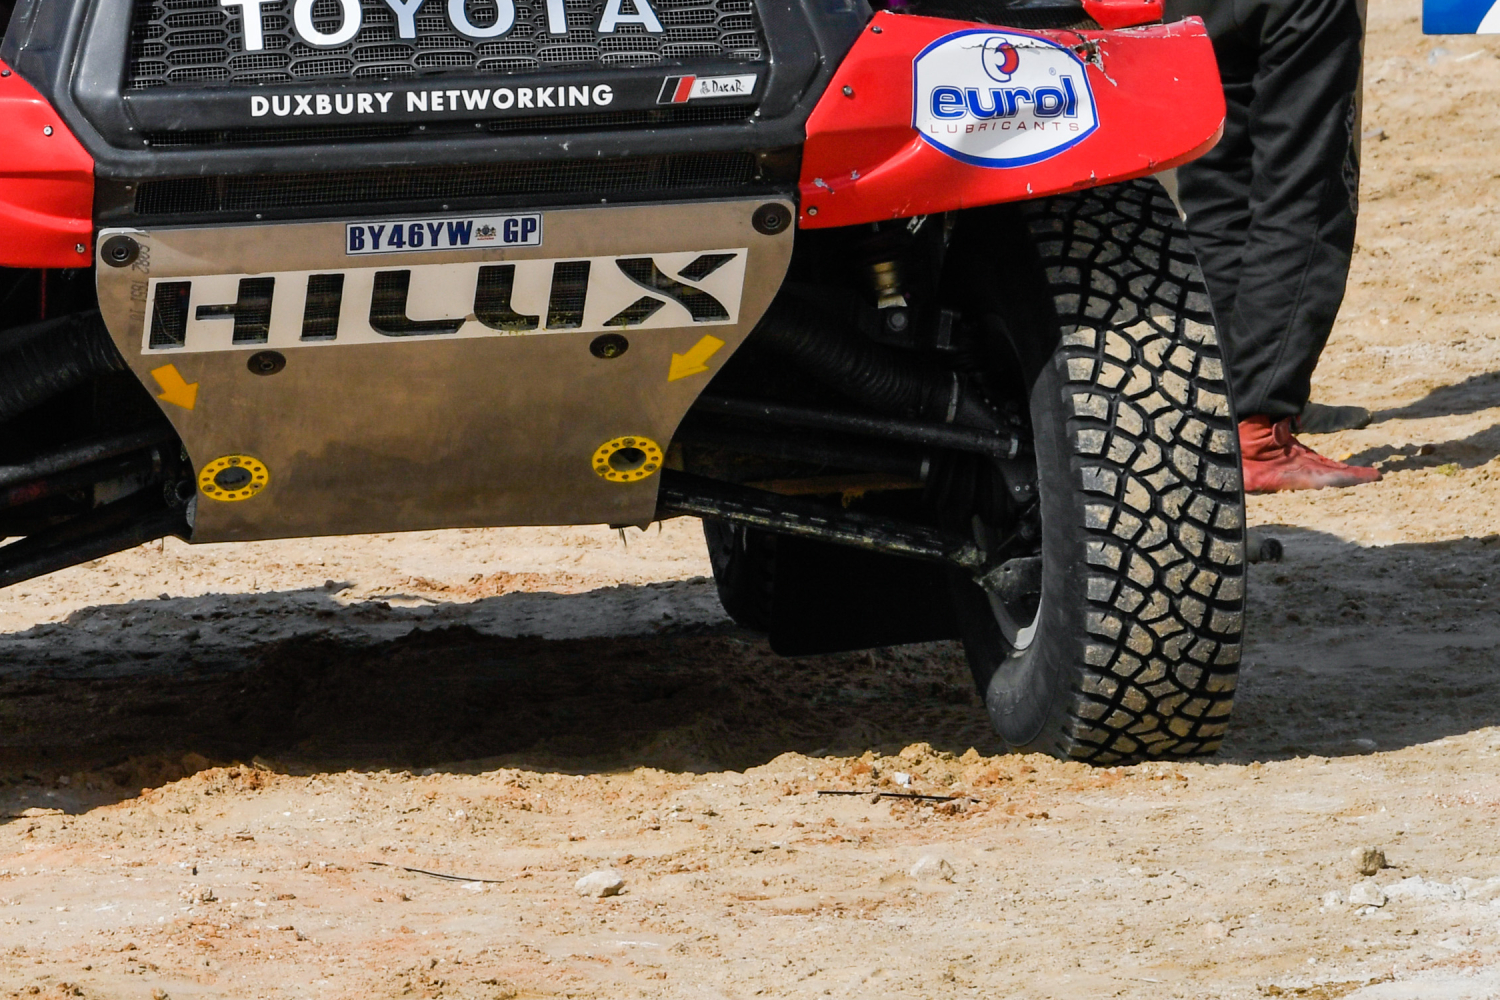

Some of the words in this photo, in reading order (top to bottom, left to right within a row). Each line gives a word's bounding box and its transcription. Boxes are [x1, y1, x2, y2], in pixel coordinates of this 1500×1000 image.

[250, 92, 392, 118] DUXBURY
[406, 84, 613, 114] NETWORKING
[711, 81, 746, 97] DAKAR
[930, 74, 1079, 121] eurol
[930, 121, 1080, 134] LUBRICANTS
[349, 219, 474, 252] BY46YW
[502, 216, 538, 248] GP
[148, 252, 737, 350] HILUX
